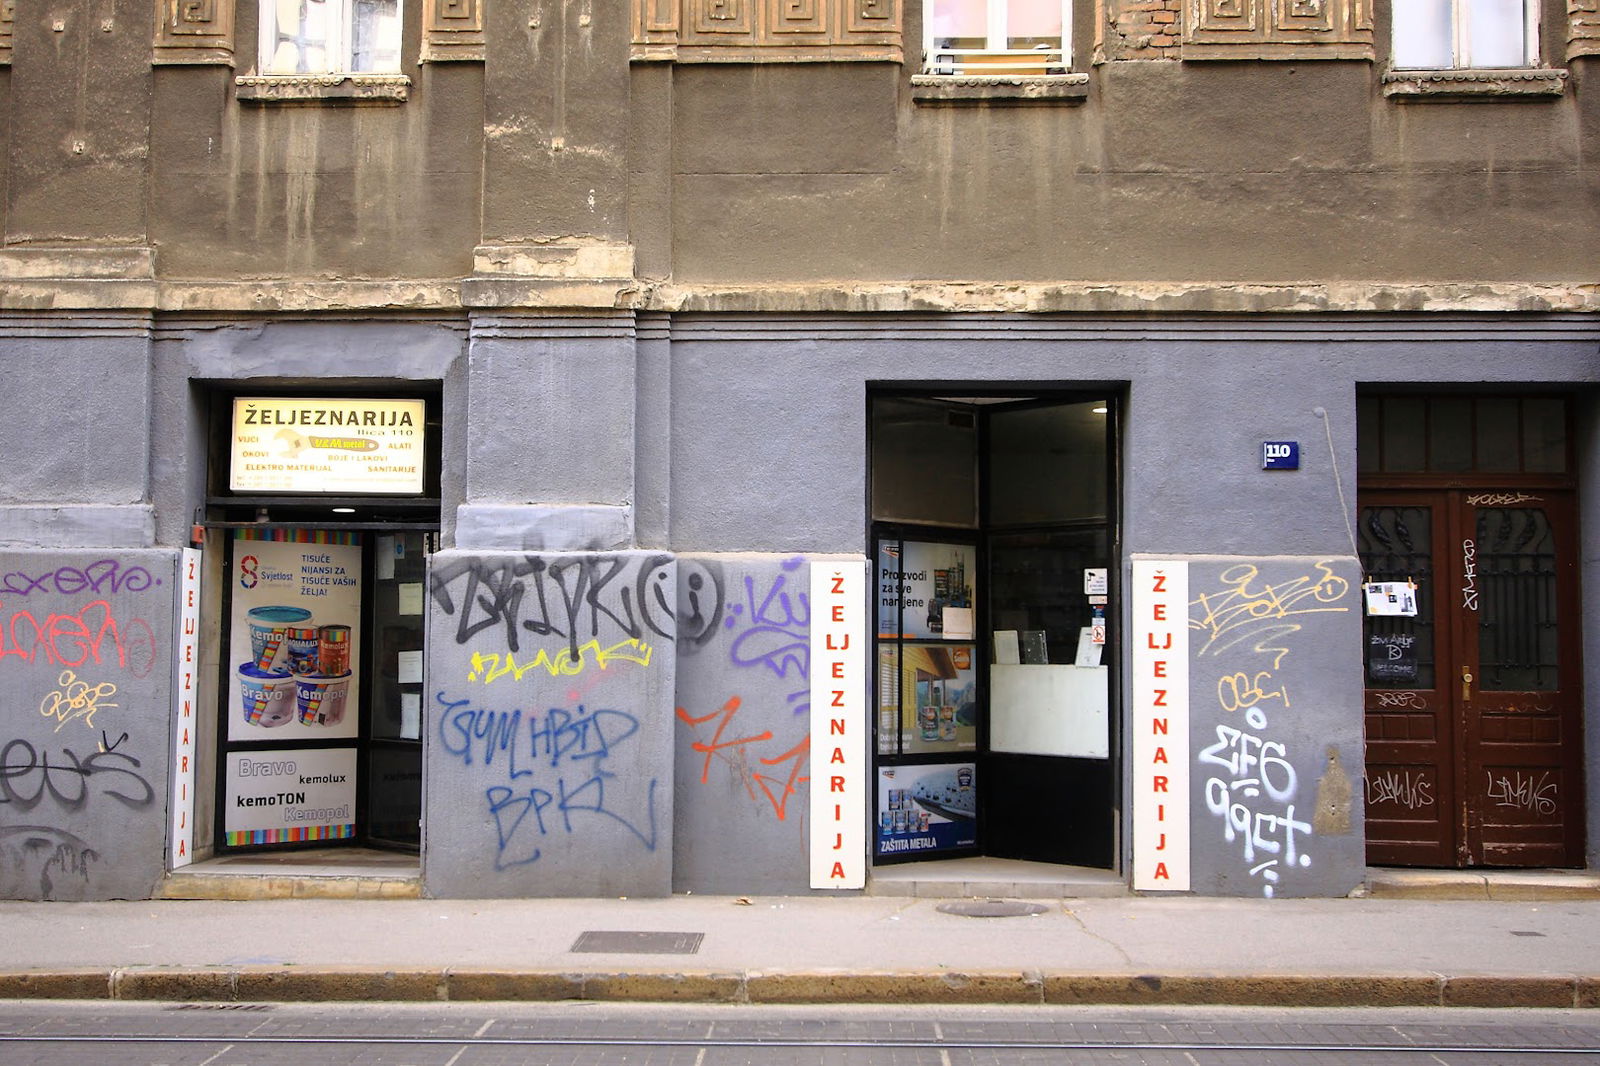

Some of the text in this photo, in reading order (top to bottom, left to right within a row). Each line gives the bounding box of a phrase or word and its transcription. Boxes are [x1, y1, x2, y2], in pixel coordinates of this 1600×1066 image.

[245, 404, 413, 426] ŽELJEZNARIJA
[388, 442, 412, 450] ALATI
[1266, 444, 1291, 458] 110
[287, 464, 333, 472] MATERIJAL
[368, 465, 417, 473] SANITARIJE
[301, 553, 330, 564] TISUĆE
[261, 571, 293, 581] Svjetlost
[301, 566, 346, 575] NIJANSI ZA
[882, 569, 927, 581] Prozvodi
[332, 576, 357, 586] VAŠIH
[301, 586, 328, 596] ŽELJA!
[882, 584, 893, 593] za
[241, 684, 283, 701] Bravo
[178, 558, 195, 857] ŽELJEZNARIJA
[826, 571, 850, 878] ŽELJEZNARIJA
[1148, 570, 1172, 879] ŽELJEZNARIJA
[239, 758, 297, 777] Bravo
[299, 774, 346, 784] kemolux
[237, 792, 305, 808] kemoTON
[284, 804, 350, 823] Kemopol
[881, 836, 937, 853] ZAŠTITA METALA
